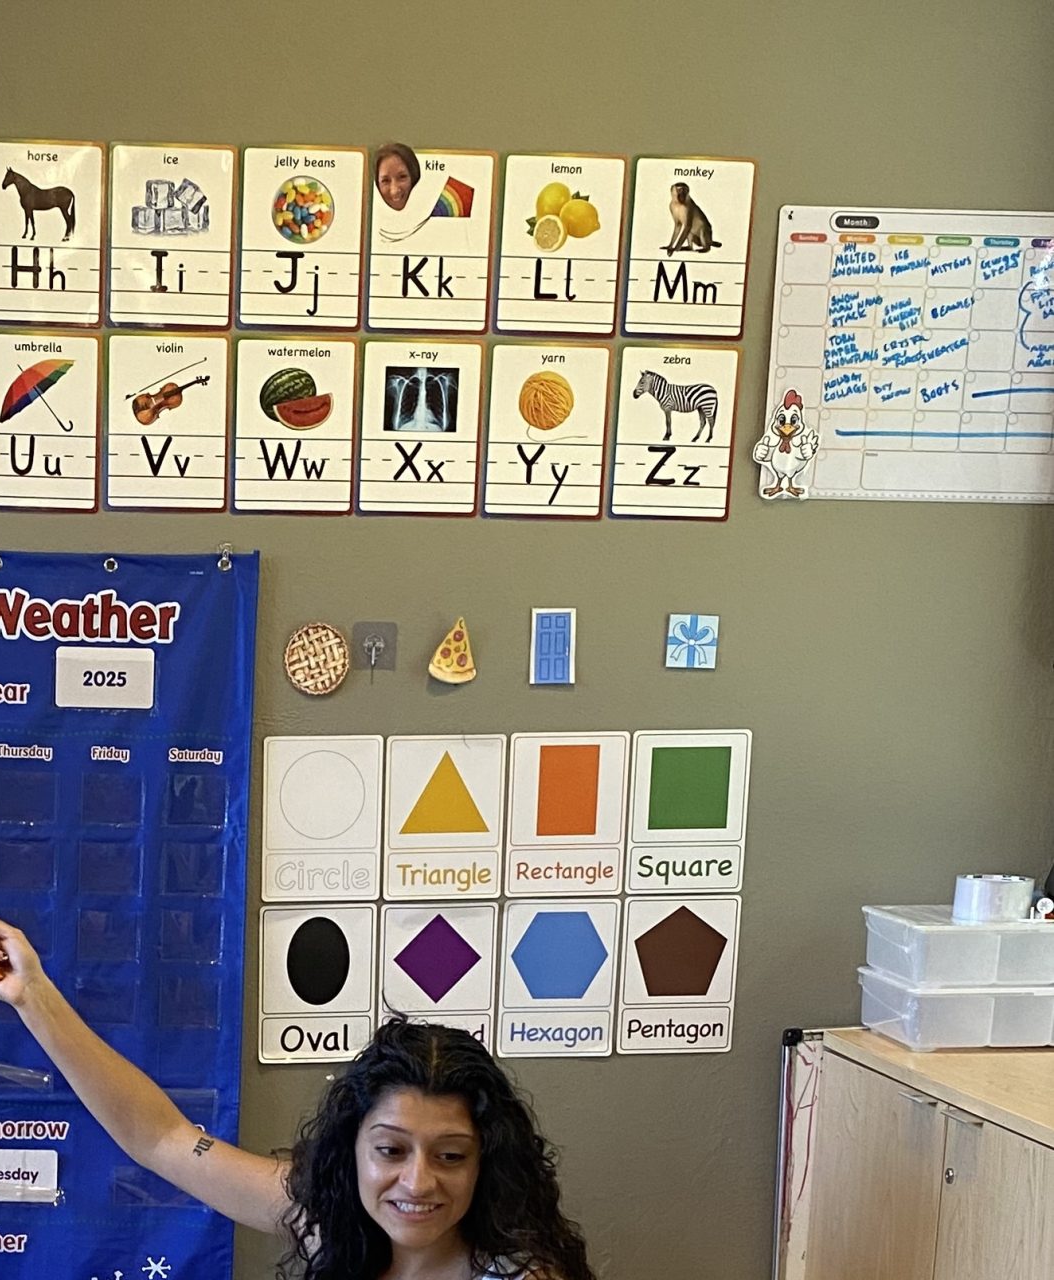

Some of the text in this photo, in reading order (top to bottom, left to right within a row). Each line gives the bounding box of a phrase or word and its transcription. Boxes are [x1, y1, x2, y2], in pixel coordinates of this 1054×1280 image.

[28, 150, 57, 161] horse
[164, 156, 178, 164] ice
[274, 156, 335, 169] jelly beans
[426, 160, 445, 171] kite
[552, 163, 582, 174] lemon
[674, 167, 714, 180] monkey
[9, 246, 66, 291] Hh
[150, 250, 184, 293] Ii
[401, 256, 454, 297] Kk
[533, 259, 576, 300] Ll
[274, 252, 319, 316] Jj
[654, 262, 717, 304] Mm
[15, 342, 62, 352] umbrella
[156, 343, 183, 353] violin
[268, 348, 330, 357] watermelon
[410, 349, 438, 361] x-ray
[542, 355, 565, 364] yarn
[664, 355, 690, 364] zebra
[10, 435, 61, 476] Uu
[142, 437, 189, 477] Vv
[260, 440, 326, 480] Ww
[393, 443, 444, 482] Xx
[646, 447, 700, 486] Zz
[517, 444, 568, 505] Yy
[83, 671, 126, 687] 2025
[91, 746, 129, 763] Friday
[168, 747, 223, 764] Saturday
[274, 860, 370, 891] Circle
[397, 862, 491, 891] Triangle
[517, 862, 613, 884] Rectangle
[638, 856, 732, 885] Square
[281, 1024, 349, 1052] Oval
[511, 1023, 603, 1047] Hexagon
[628, 1019, 724, 1044] Pentagon
